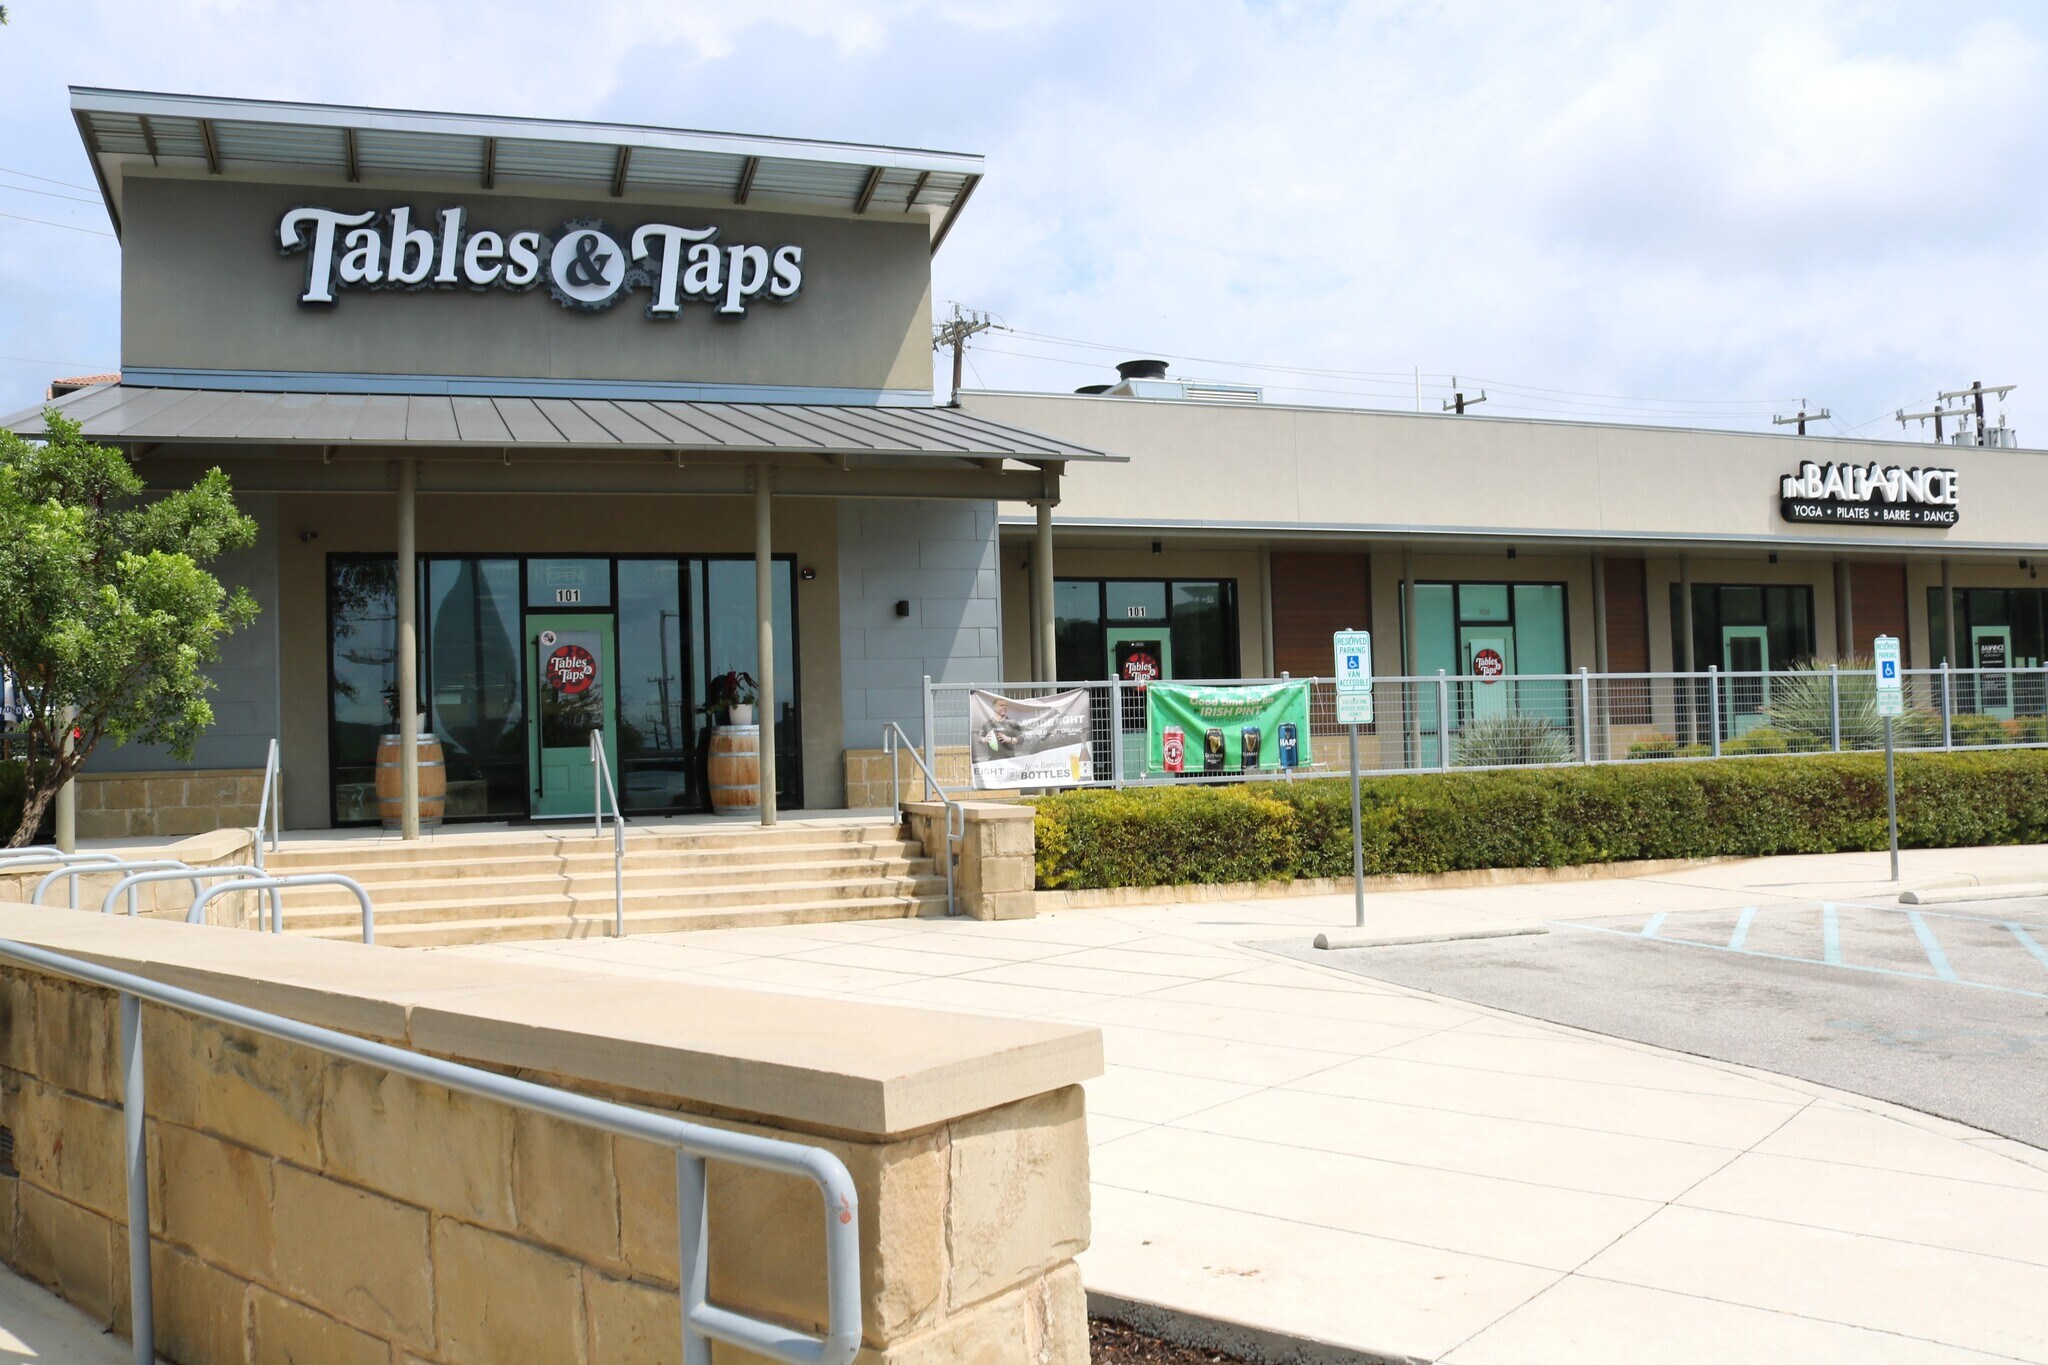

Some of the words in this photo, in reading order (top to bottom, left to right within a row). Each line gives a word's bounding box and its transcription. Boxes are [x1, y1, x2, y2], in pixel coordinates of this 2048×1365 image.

[280, 206, 540, 302] Tables
[566, 234, 613, 288] &
[631, 223, 802, 314] Taps
[1794, 505, 1823, 517] YOGA
[1836, 508, 1870, 520] PILATES
[1883, 510, 1910, 521] BARRE
[1923, 511, 1954, 522] DANCE
[558, 589, 579, 602] 101
[1128, 607, 1145, 617] 101
[1337, 637, 1367, 645] RESERVED
[1340, 646, 1366, 654] PARKING
[551, 656, 588, 671] Tables
[1126, 661, 1152, 673] Tables
[1475, 656, 1498, 668] Tables
[558, 669, 585, 683] Taps
[1340, 679, 1369, 687] ACCESSIBLE
[1190, 696, 1218, 706] Good
[1221, 697, 1244, 706] time
[1246, 697, 1260, 705] for
[1200, 707, 1233, 717] IRISH
[1235, 706, 1262, 716] PINT
[1280, 738, 1296, 746] HARP
[974, 767, 1005, 776] EIGHT
[1021, 769, 1071, 780] BOTTLES
